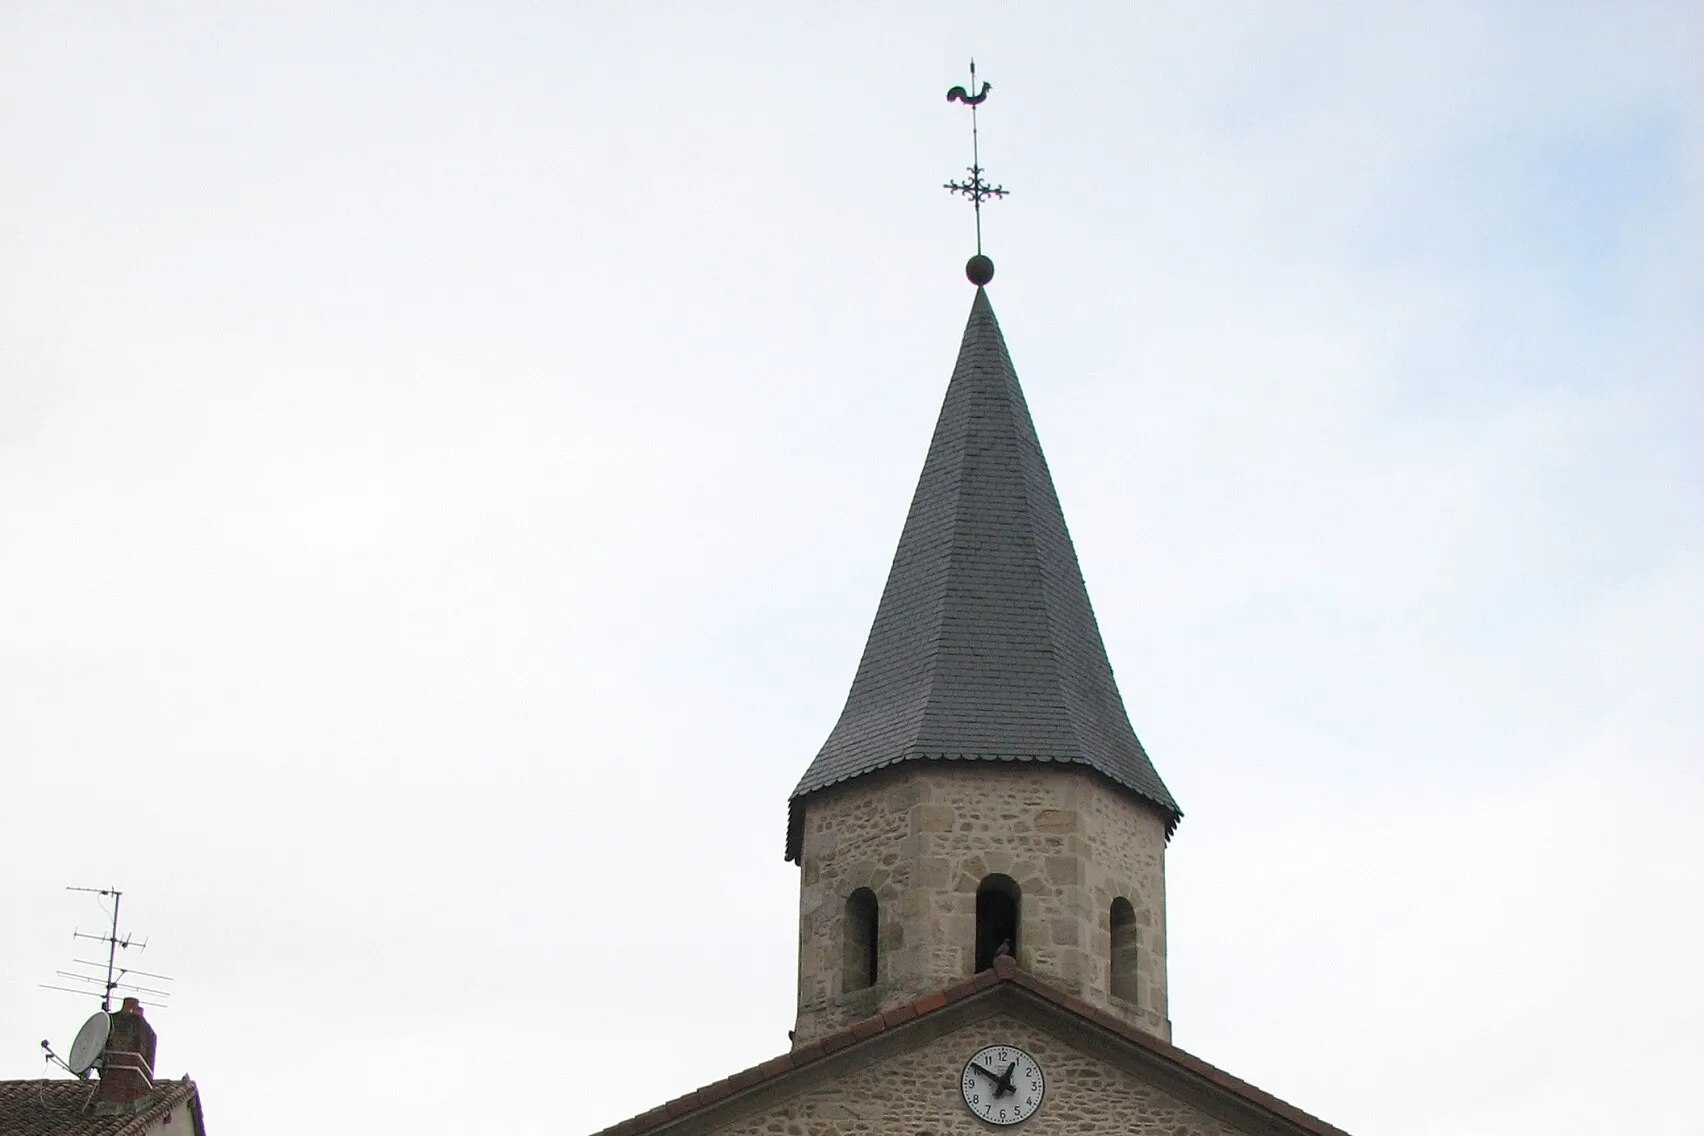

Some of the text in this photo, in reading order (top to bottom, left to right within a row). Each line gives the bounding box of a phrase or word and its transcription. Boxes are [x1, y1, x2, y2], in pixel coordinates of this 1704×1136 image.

[985, 1056, 992, 1065] 11
[998, 1052, 1007, 1061] 12
[1016, 1057, 1020, 1066] 1
[1026, 1068, 1032, 1077] 2
[968, 1080, 975, 1088] 9
[1032, 1082, 1038, 1092] 3
[973, 1094, 979, 1104] 8
[1026, 1097, 1032, 1106] 4
[985, 1105, 991, 1114] 7
[1000, 1109, 1006, 1118] 6
[1014, 1106, 1020, 1116] 5
